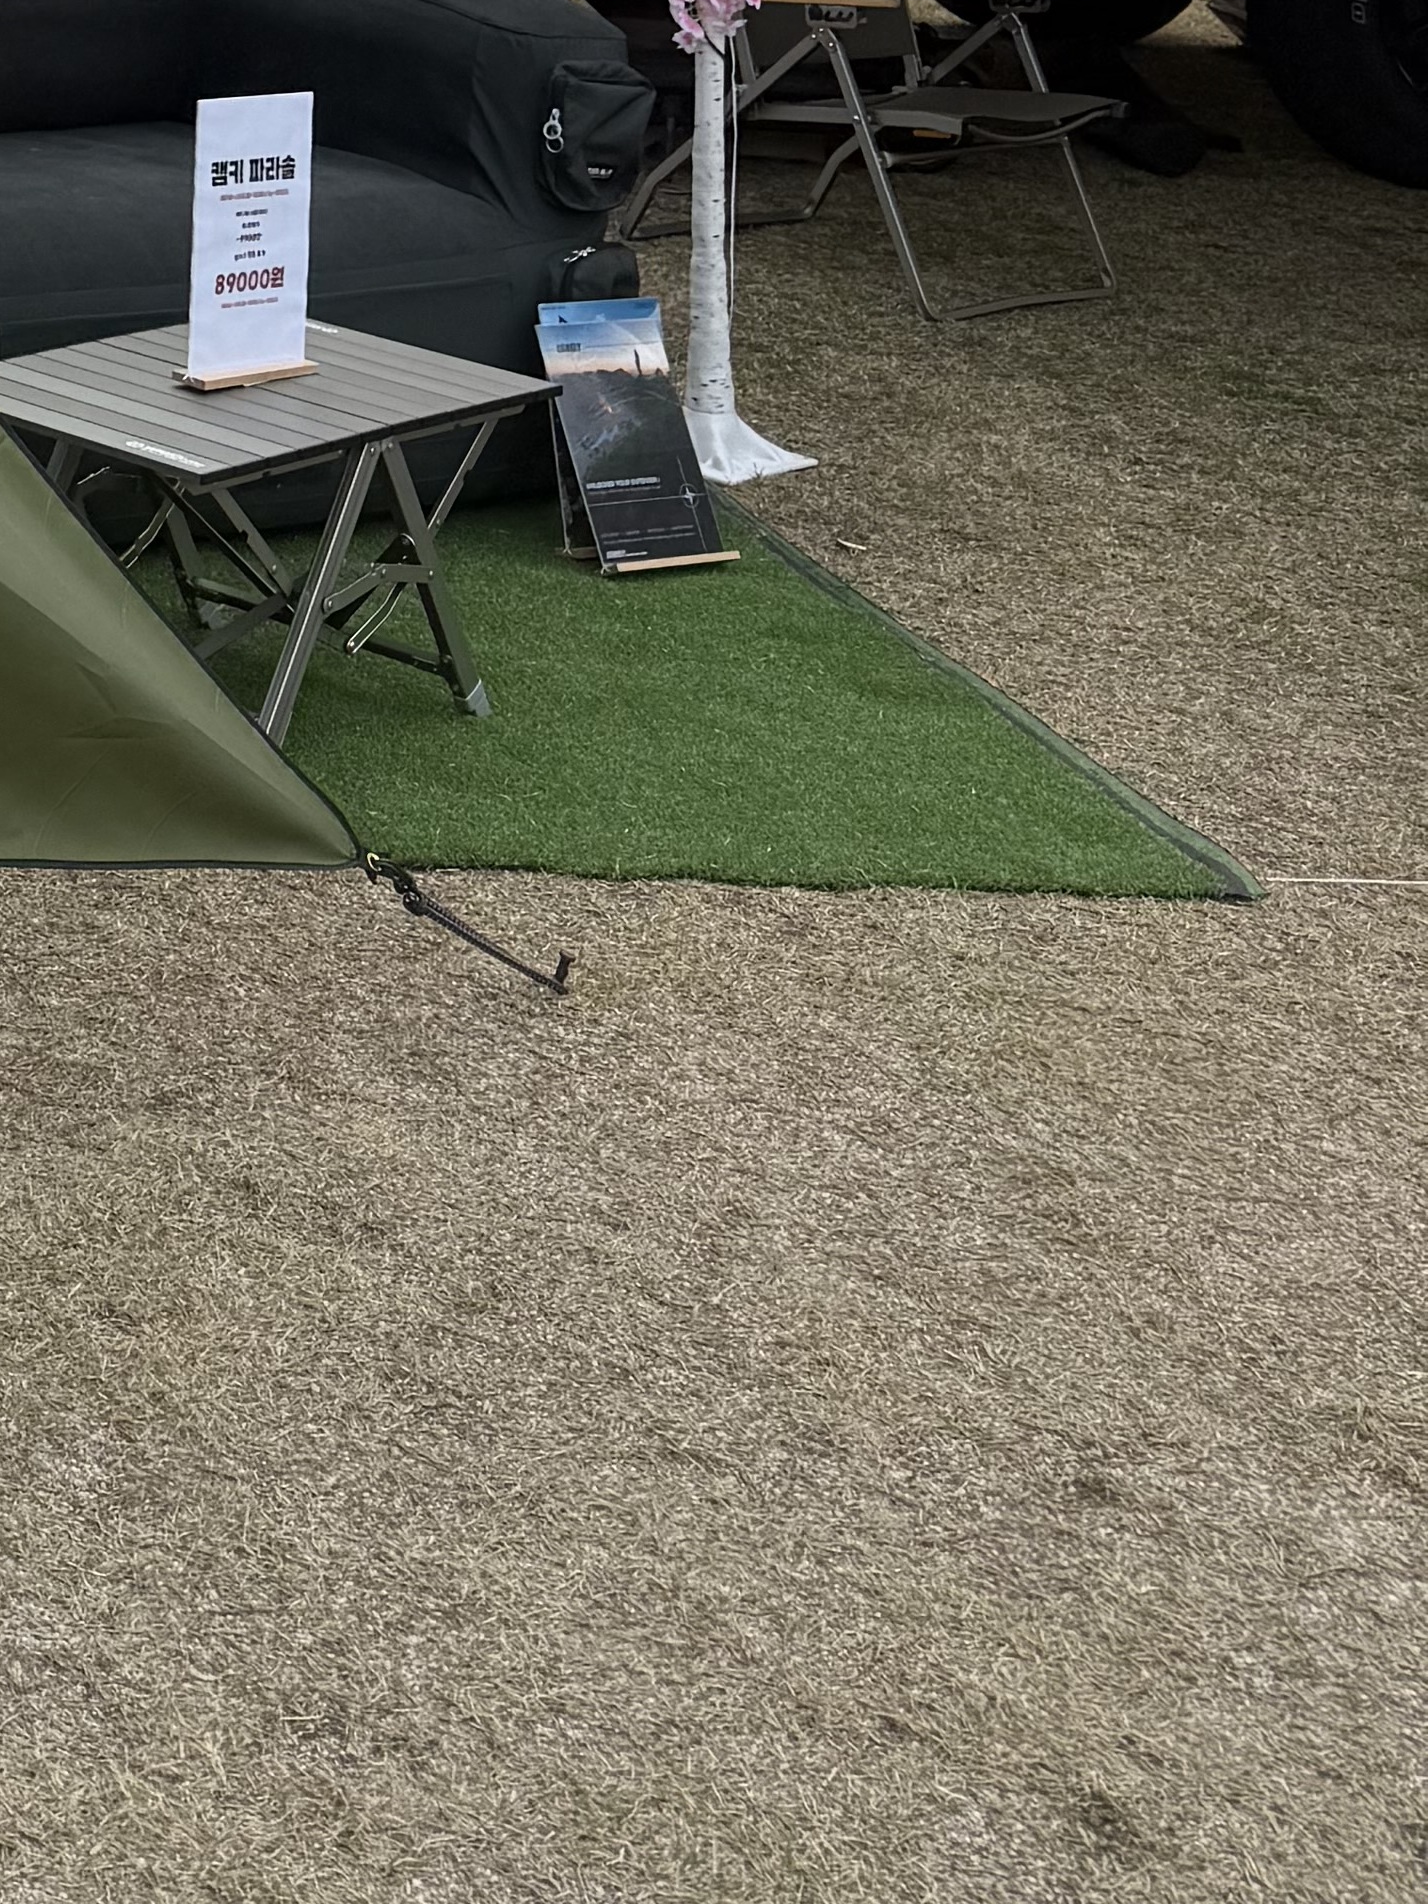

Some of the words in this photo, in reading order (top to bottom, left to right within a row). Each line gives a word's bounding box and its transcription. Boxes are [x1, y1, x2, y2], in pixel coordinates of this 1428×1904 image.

[211, 159, 245, 187] 캠키
[249, 155, 296, 182] 파라솔
[214, 266, 286, 295] 89000원
